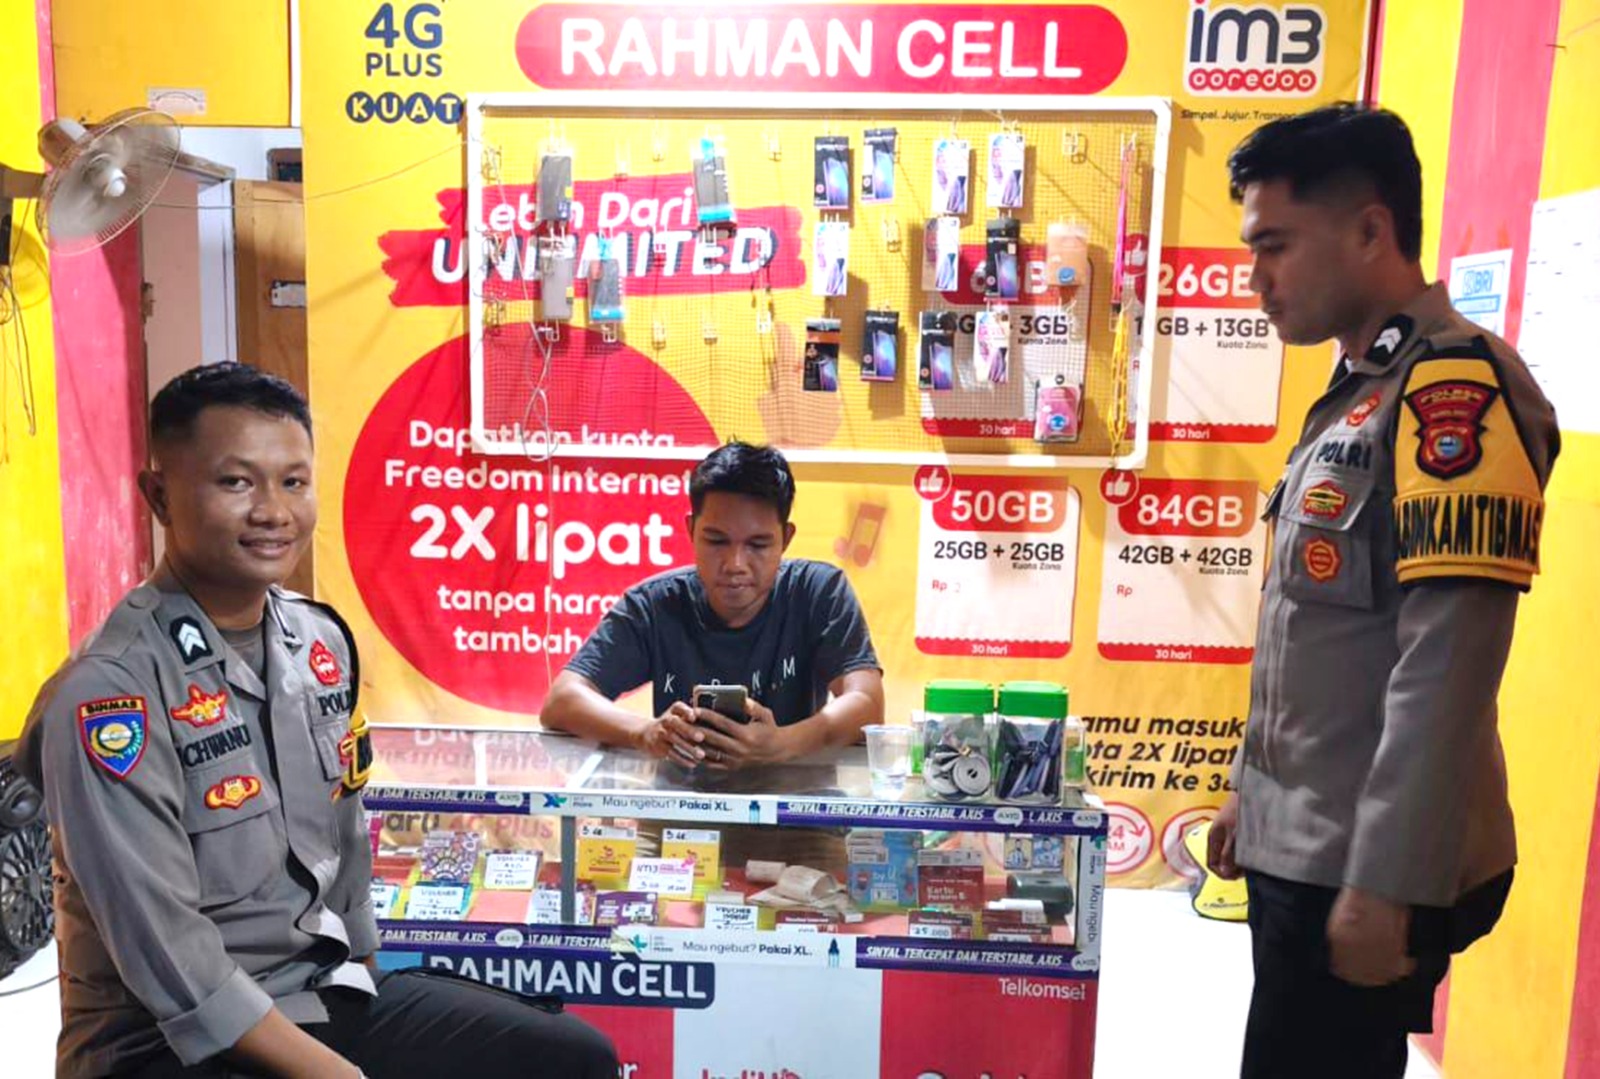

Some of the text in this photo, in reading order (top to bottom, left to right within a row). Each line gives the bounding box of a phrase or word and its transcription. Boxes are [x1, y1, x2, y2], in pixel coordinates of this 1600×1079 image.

[364, 3, 443, 49] 4G
[560, 17, 1082, 78] RAHMAN CELL
[366, 54, 441, 76] PLUS
[1190, 69, 1315, 90] ooredoo
[349, 94, 461, 122] KUAT
[598, 187, 694, 227] Dari
[1134, 316, 1189, 337] 1GB
[1214, 317, 1269, 338] 13GB
[1217, 341, 1268, 350] Kuota Zona
[1172, 427, 1209, 440] 30 hari
[1316, 441, 1371, 470] POLRI
[385, 459, 543, 492] Freedom
[951, 489, 1055, 523] 50GB
[1137, 494, 1243, 528] 84GB
[410, 503, 674, 579] 2X lipat
[934, 540, 988, 560] 25GB
[1010, 542, 1064, 562] 25GB
[1119, 545, 1174, 565] 42GB
[1197, 547, 1253, 567] 42GB
[932, 579, 947, 591] Rp
[1117, 584, 1133, 597] Rp
[437, 585, 535, 618] tanpa
[971, 643, 1008, 656] 30 hari
[1155, 648, 1192, 661] 30 hari
[86, 700, 137, 714] BINMAS
[1081, 716, 1245, 739] amu masuk
[1129, 742, 1165, 762] 2X
[1164, 769, 1199, 791] ke
[602, 796, 628, 808] Mau
[630, 798, 677, 810] ngebut?
[679, 800, 711, 811] Pakai
[787, 802, 984, 820] SINYAL TERCEPAT DAN TERSTABIL AXIS
[1037, 811, 1064, 824] AXIS
[1090, 885, 1101, 911] Mau
[385, 929, 407, 940] DAN
[410, 930, 460, 942] TERSTABIL
[462, 931, 488, 944] AXIS
[541, 934, 562, 946] DAN
[564, 936, 612, 950] TERSTAB
[682, 941, 708, 952] Mau
[710, 942, 757, 955] ngebut?
[759, 943, 792, 956] Pakai
[865, 945, 1063, 967] SINYAL TERCEPAT DAN TERSTABIL AXIS
[612, 963, 706, 999] CELL
[999, 977, 1087, 1000] Telkomsel
